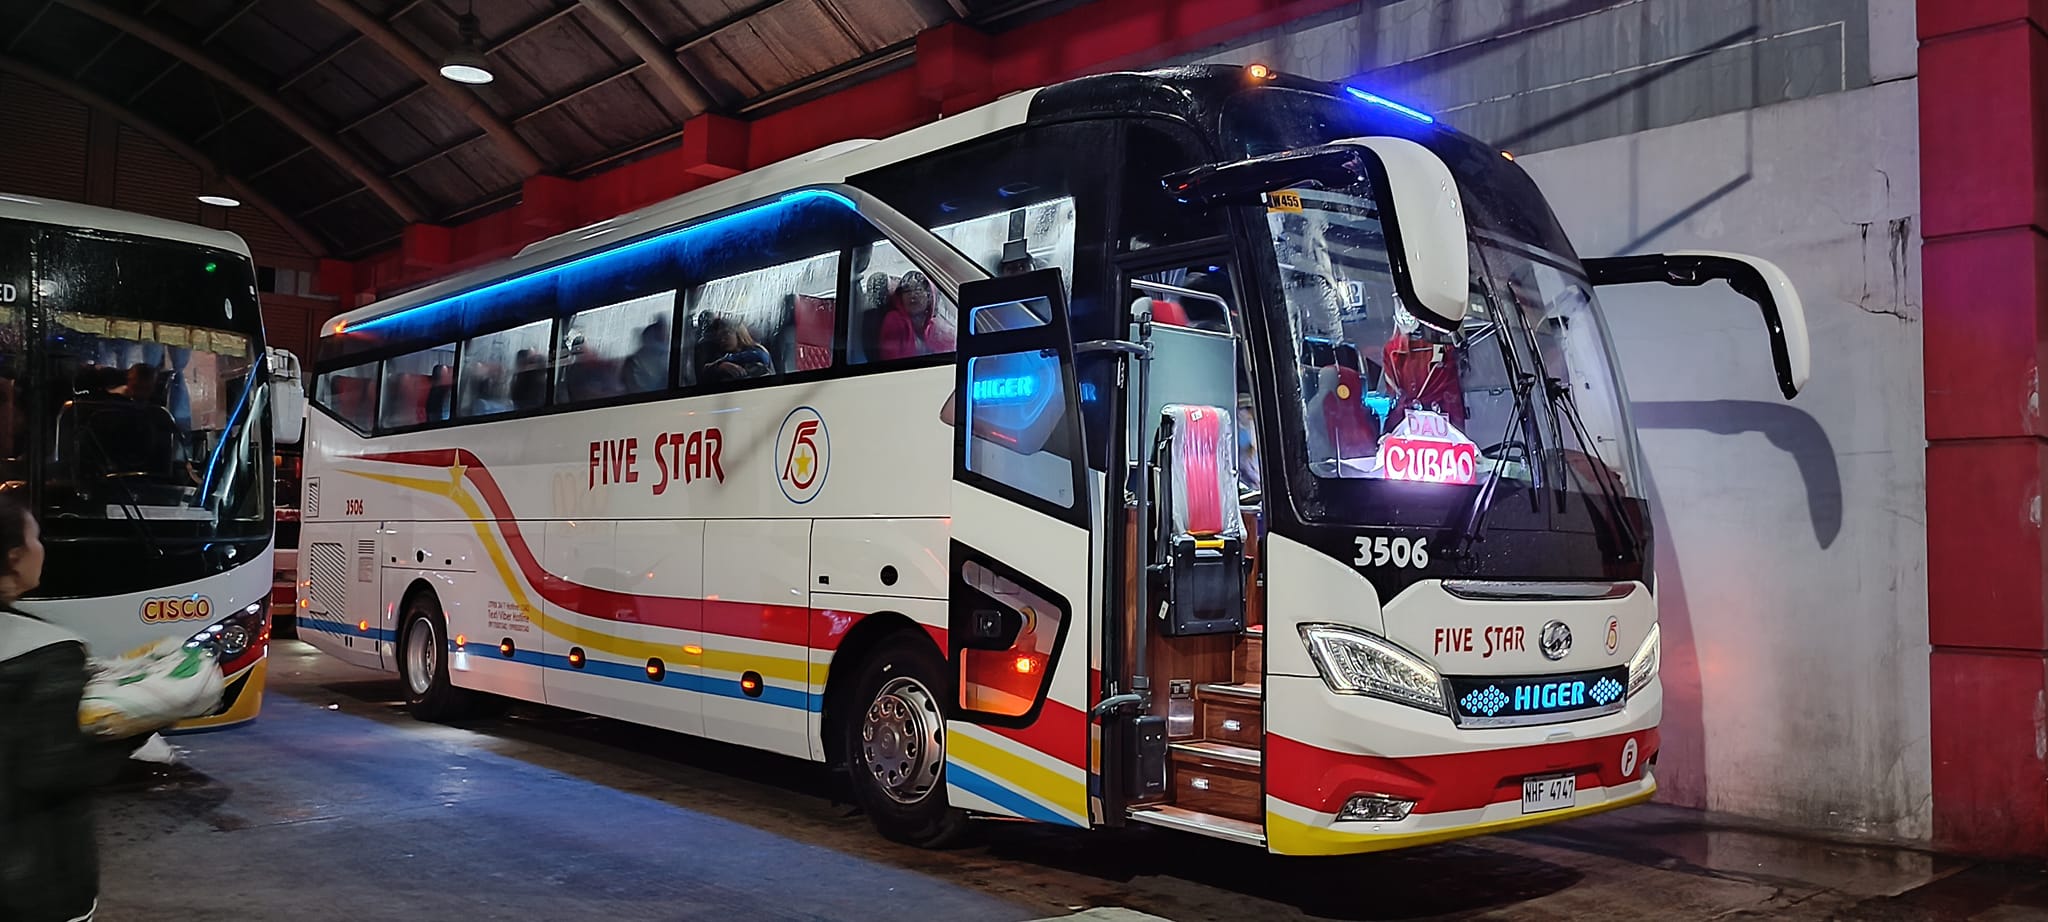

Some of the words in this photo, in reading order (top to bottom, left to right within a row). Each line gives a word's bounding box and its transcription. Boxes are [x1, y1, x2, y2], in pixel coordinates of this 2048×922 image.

[973, 376, 1032, 400] HIGER
[1408, 413, 1448, 437] DAU
[589, 437, 639, 491] FIVE
[652, 427, 725, 496] STAR
[1386, 445, 1474, 484] CUBAO
[345, 498, 364, 516] 3506
[1353, 535, 1429, 569] 3506
[144, 599, 210, 620] CISCO
[1434, 627, 1473, 656] FIVE
[1482, 625, 1526, 658] STAR
[1514, 680, 1585, 711] HIGER
[1525, 782, 1544, 803] NHF
[1549, 779, 1574, 801] 4747
